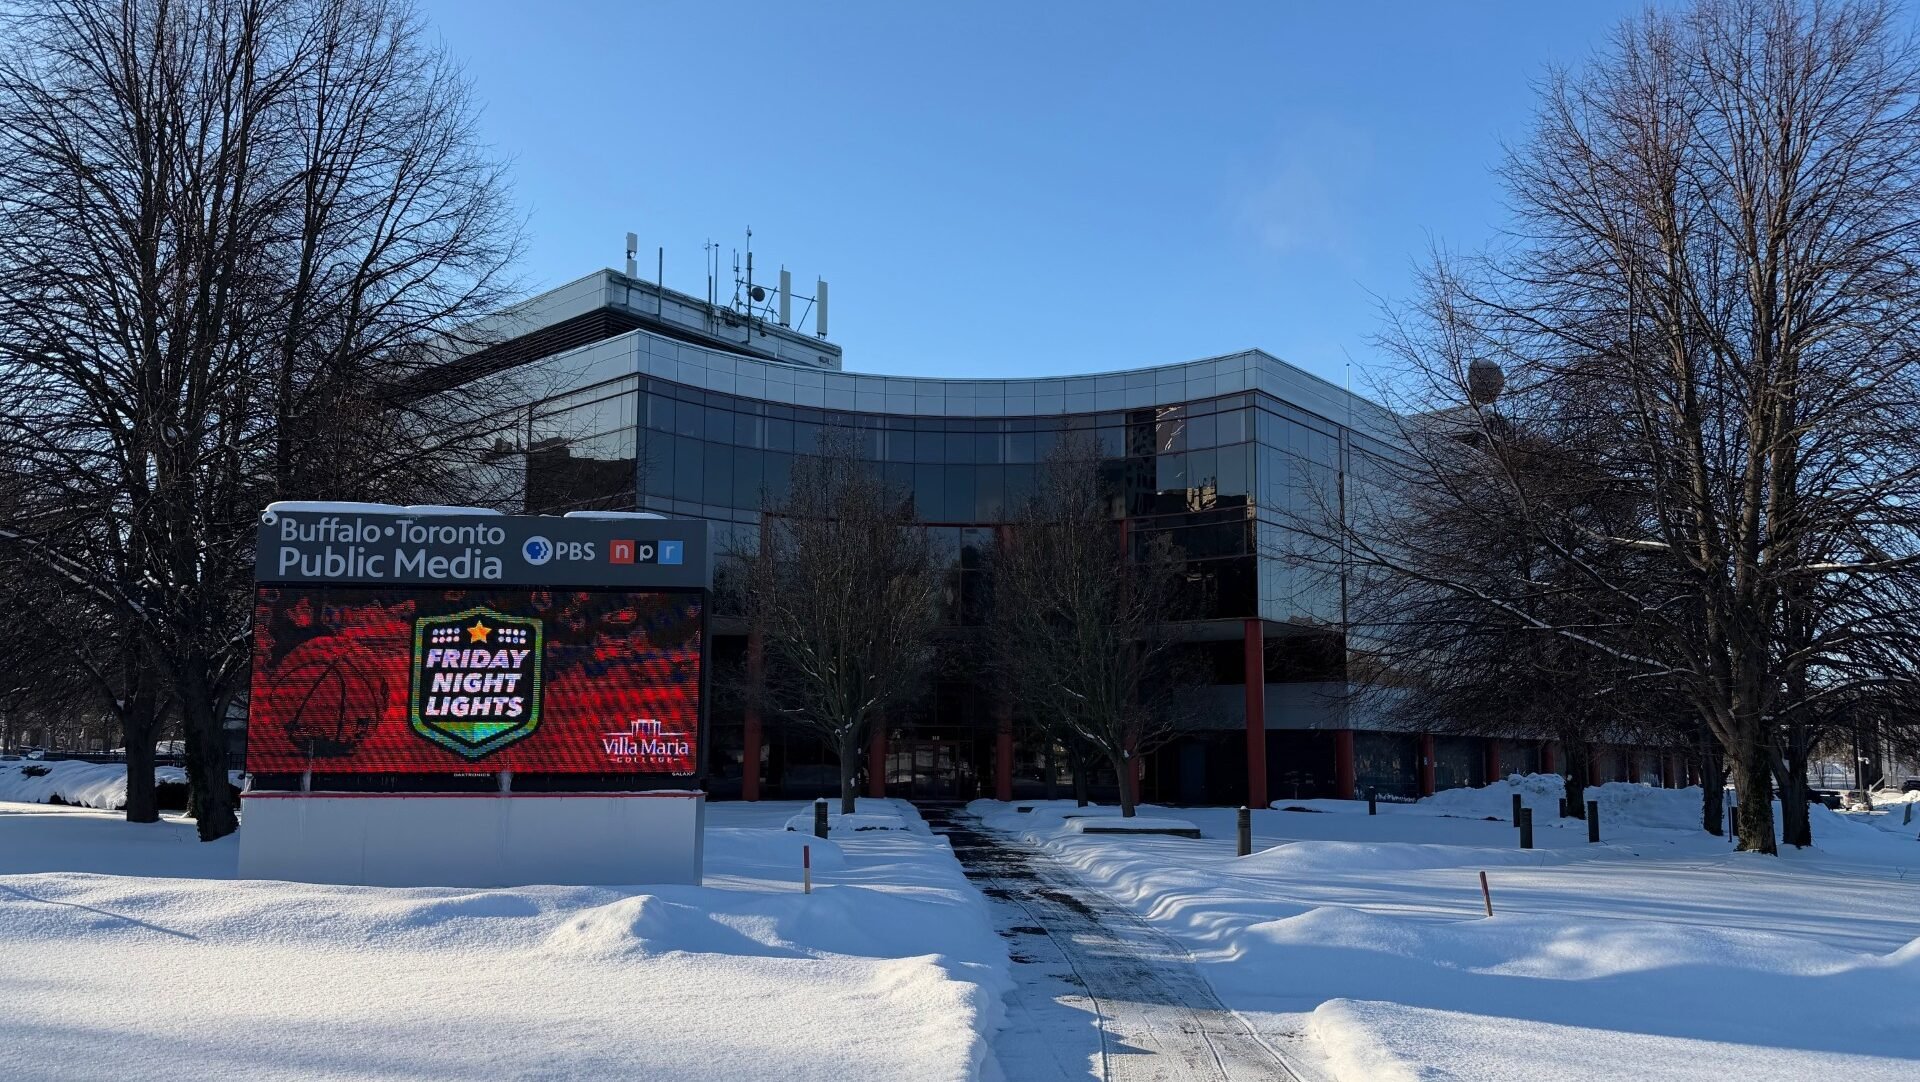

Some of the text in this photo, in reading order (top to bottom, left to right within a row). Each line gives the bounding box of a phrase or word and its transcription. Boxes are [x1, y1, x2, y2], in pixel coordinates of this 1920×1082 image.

[555, 541, 596, 561] PBS
[614, 543, 677, 562] npr
[278, 546, 503, 580] Public Media
[426, 648, 531, 669] FRIDAY
[431, 672, 523, 693] NIGHT
[425, 695, 525, 717] LIGHTS
[602, 736, 689, 755] Villa Maria
[616, 756, 673, 764] COLLEGE
